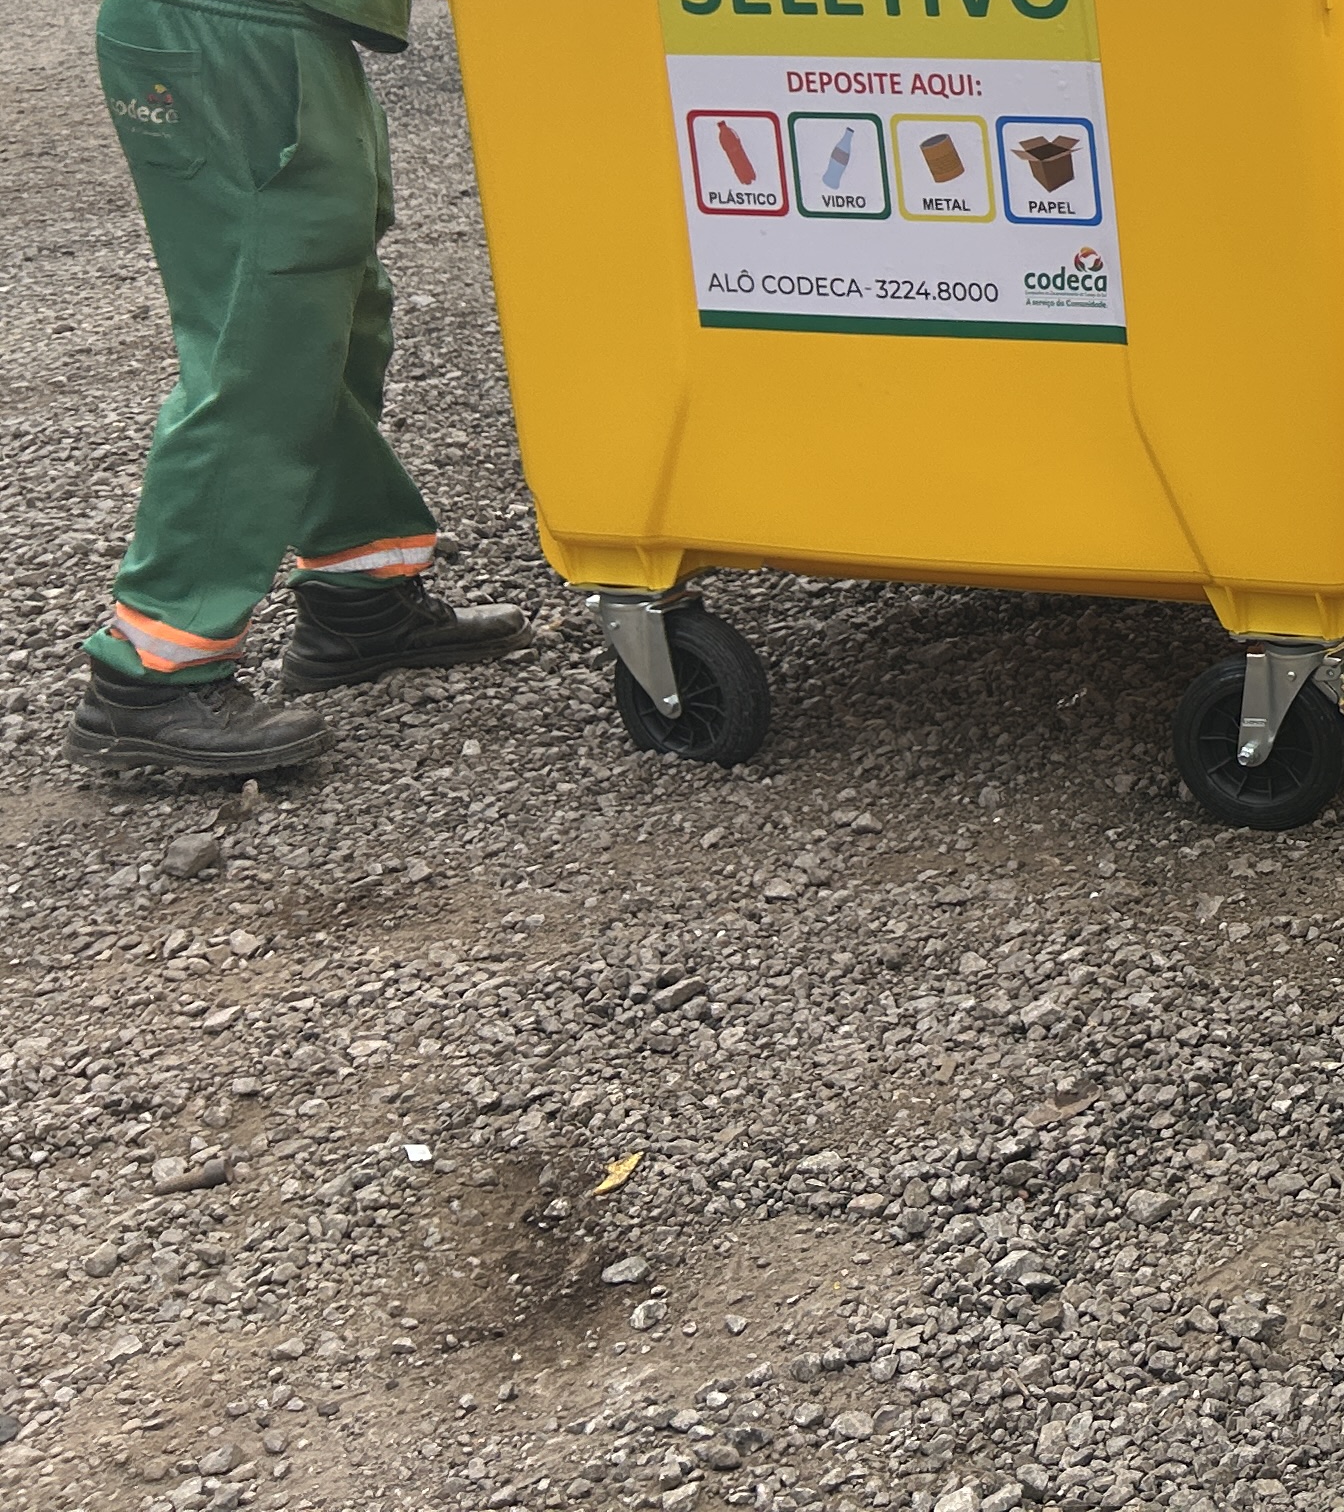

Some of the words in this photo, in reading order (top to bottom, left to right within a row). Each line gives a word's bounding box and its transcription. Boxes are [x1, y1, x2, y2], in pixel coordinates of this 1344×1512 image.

[786, 71, 903, 95] DEPOSITE
[911, 73, 983, 99] AQUI:
[709, 189, 777, 206] PLÁSTICO
[822, 195, 866, 208] VIDRO
[922, 198, 971, 211] METAL
[1028, 201, 1076, 214] PAPEL
[708, 269, 755, 293] ALÔ
[1024, 266, 1107, 292] codeca
